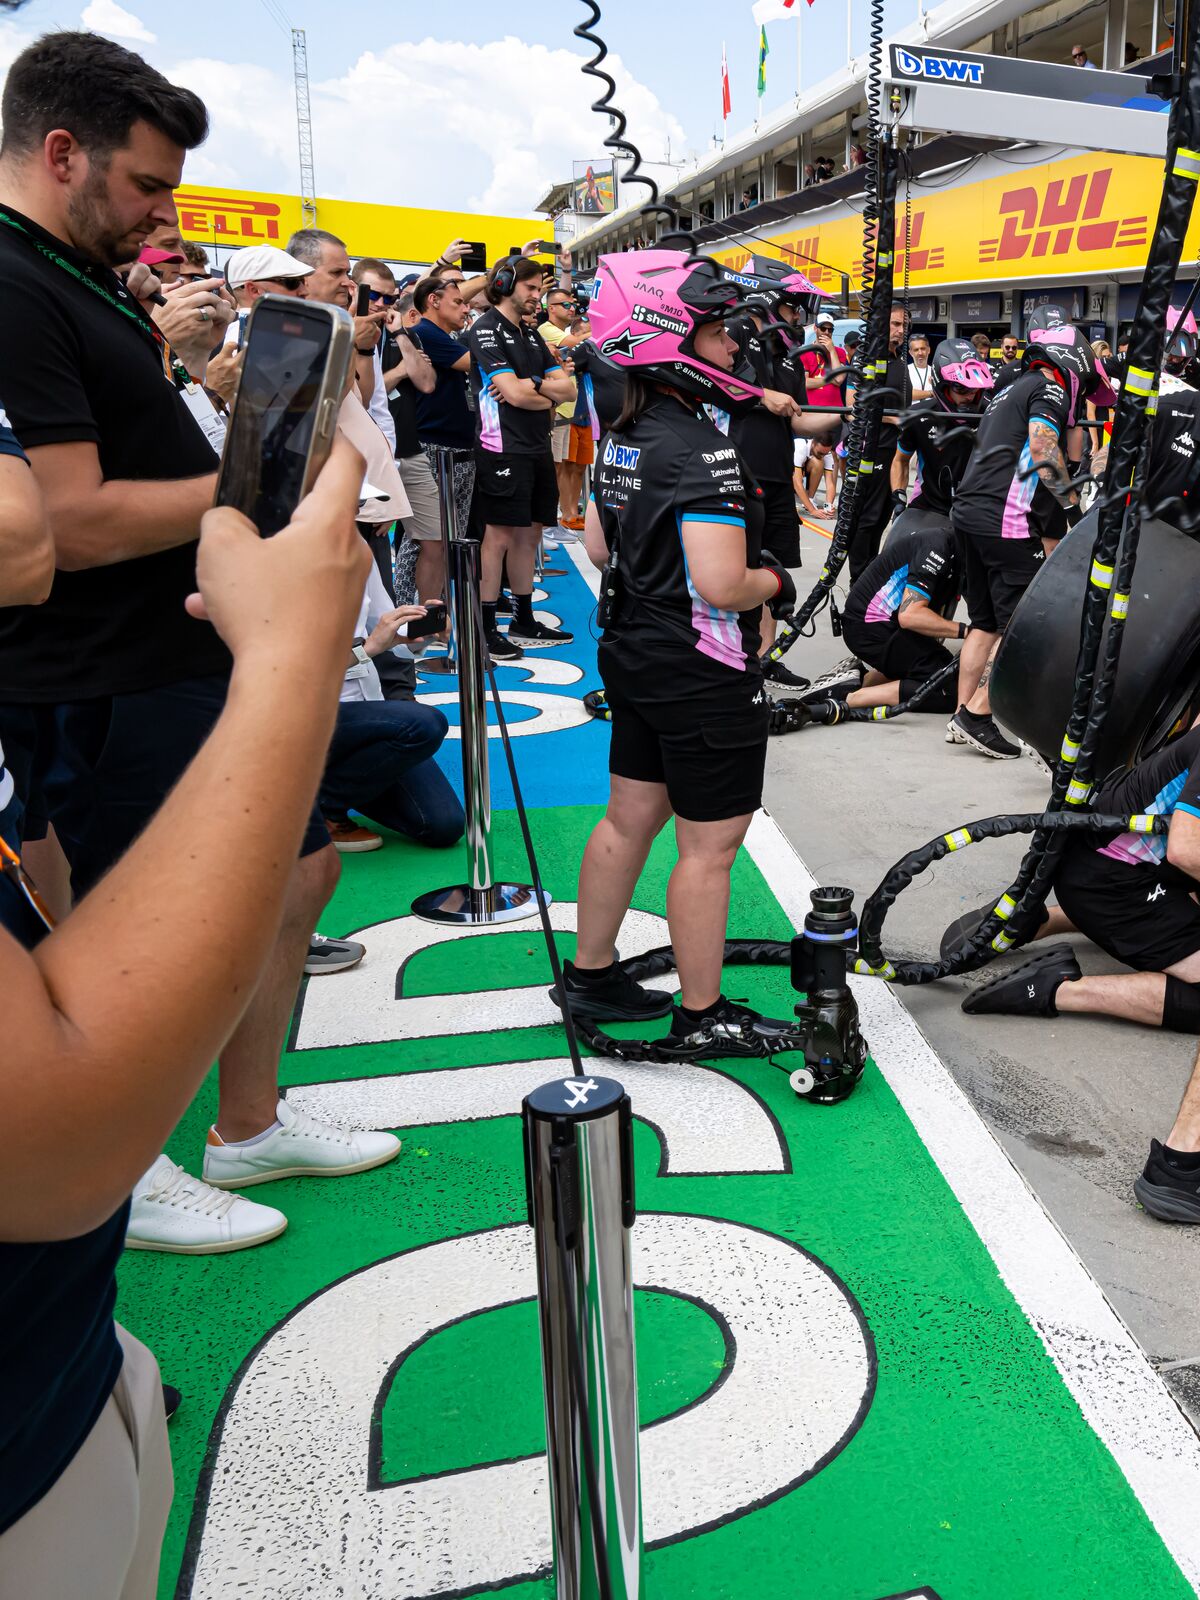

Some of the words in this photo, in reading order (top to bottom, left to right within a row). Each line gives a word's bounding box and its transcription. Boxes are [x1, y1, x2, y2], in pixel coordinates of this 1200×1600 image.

[922, 57, 985, 86] BWT
[181, 211, 279, 239] ELLI
[997, 168, 1119, 262] DHL
[633, 281, 665, 301] JAAQ
[1023, 299, 1035, 314] 23
[646, 312, 689, 335] shamir
[682, 366, 714, 388] BINANCE
[615, 444, 641, 470] BWT
[714, 448, 737, 461] BWT
